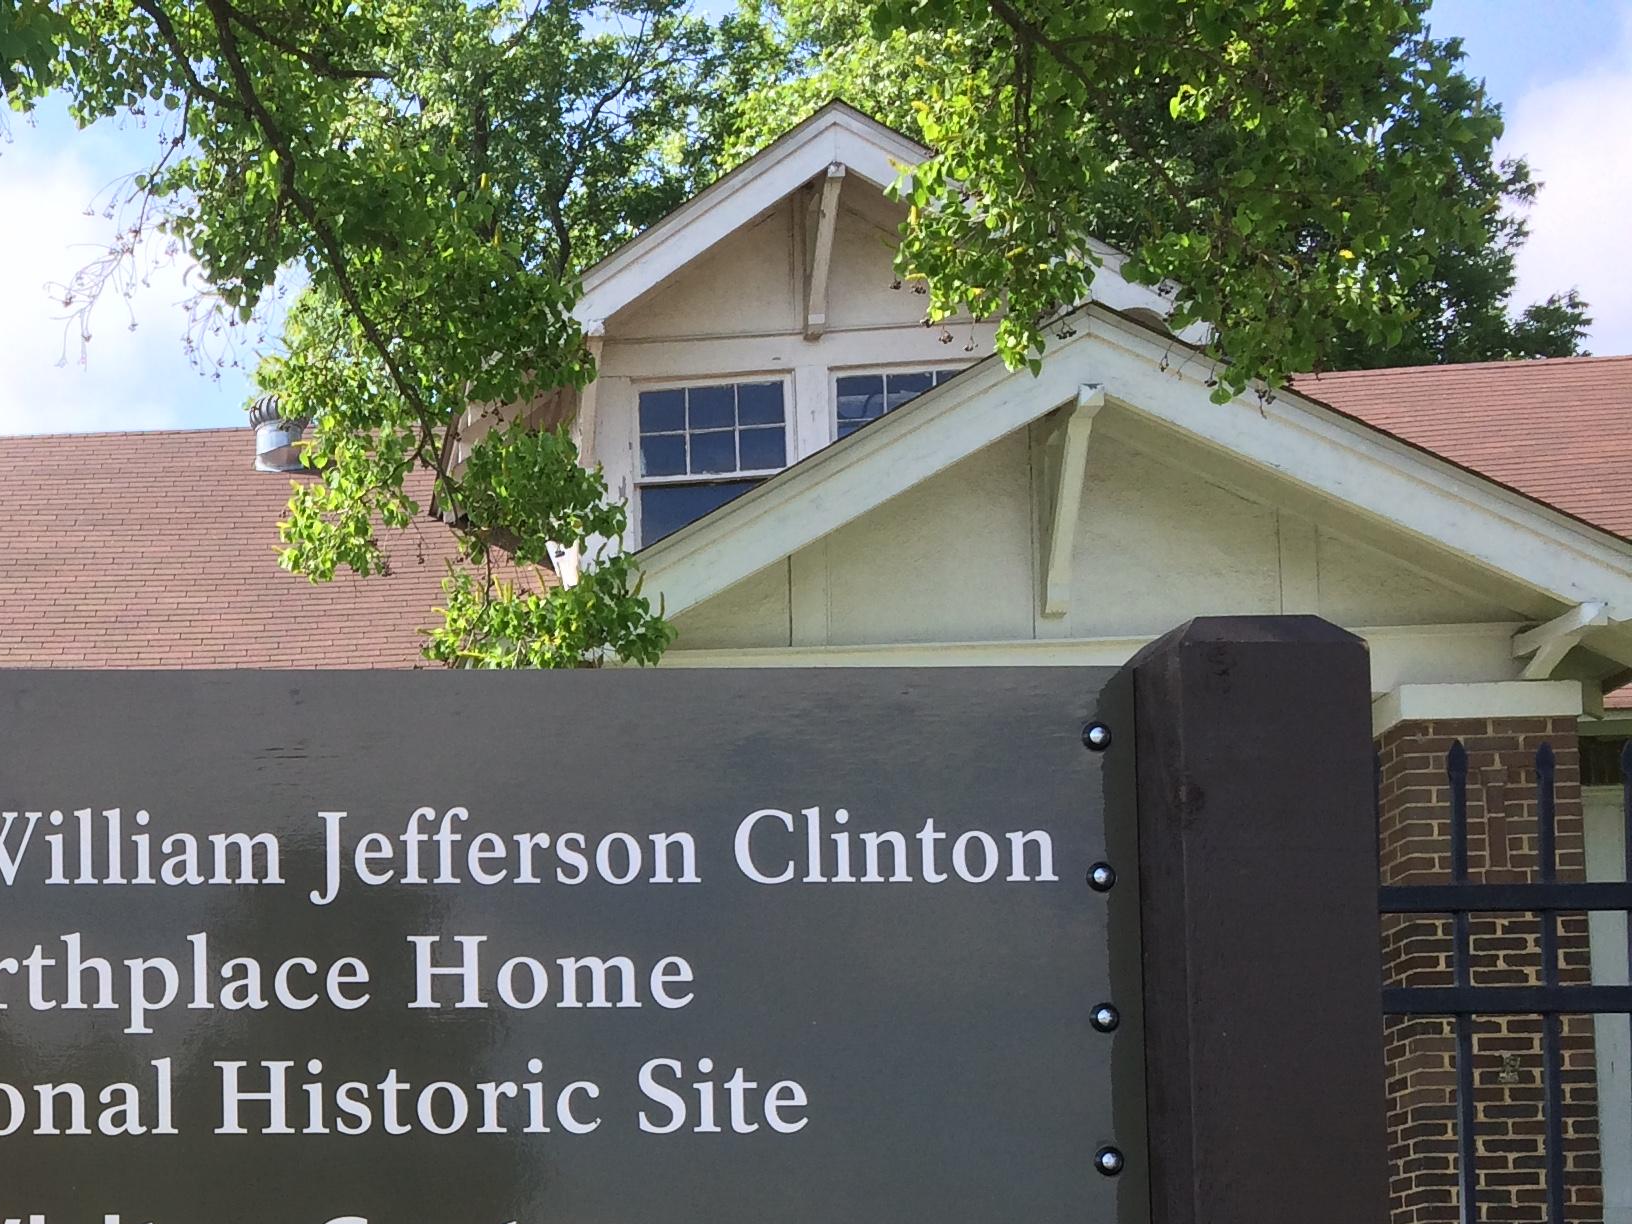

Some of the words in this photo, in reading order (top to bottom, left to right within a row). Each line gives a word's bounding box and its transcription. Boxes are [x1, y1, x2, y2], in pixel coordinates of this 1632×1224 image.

[310, 807, 701, 905] Jefferson
[735, 807, 1060, 886] Clinton
[407, 934, 695, 1011] Home
[214, 1057, 603, 1136] Historic
[638, 1057, 810, 1136] Site
